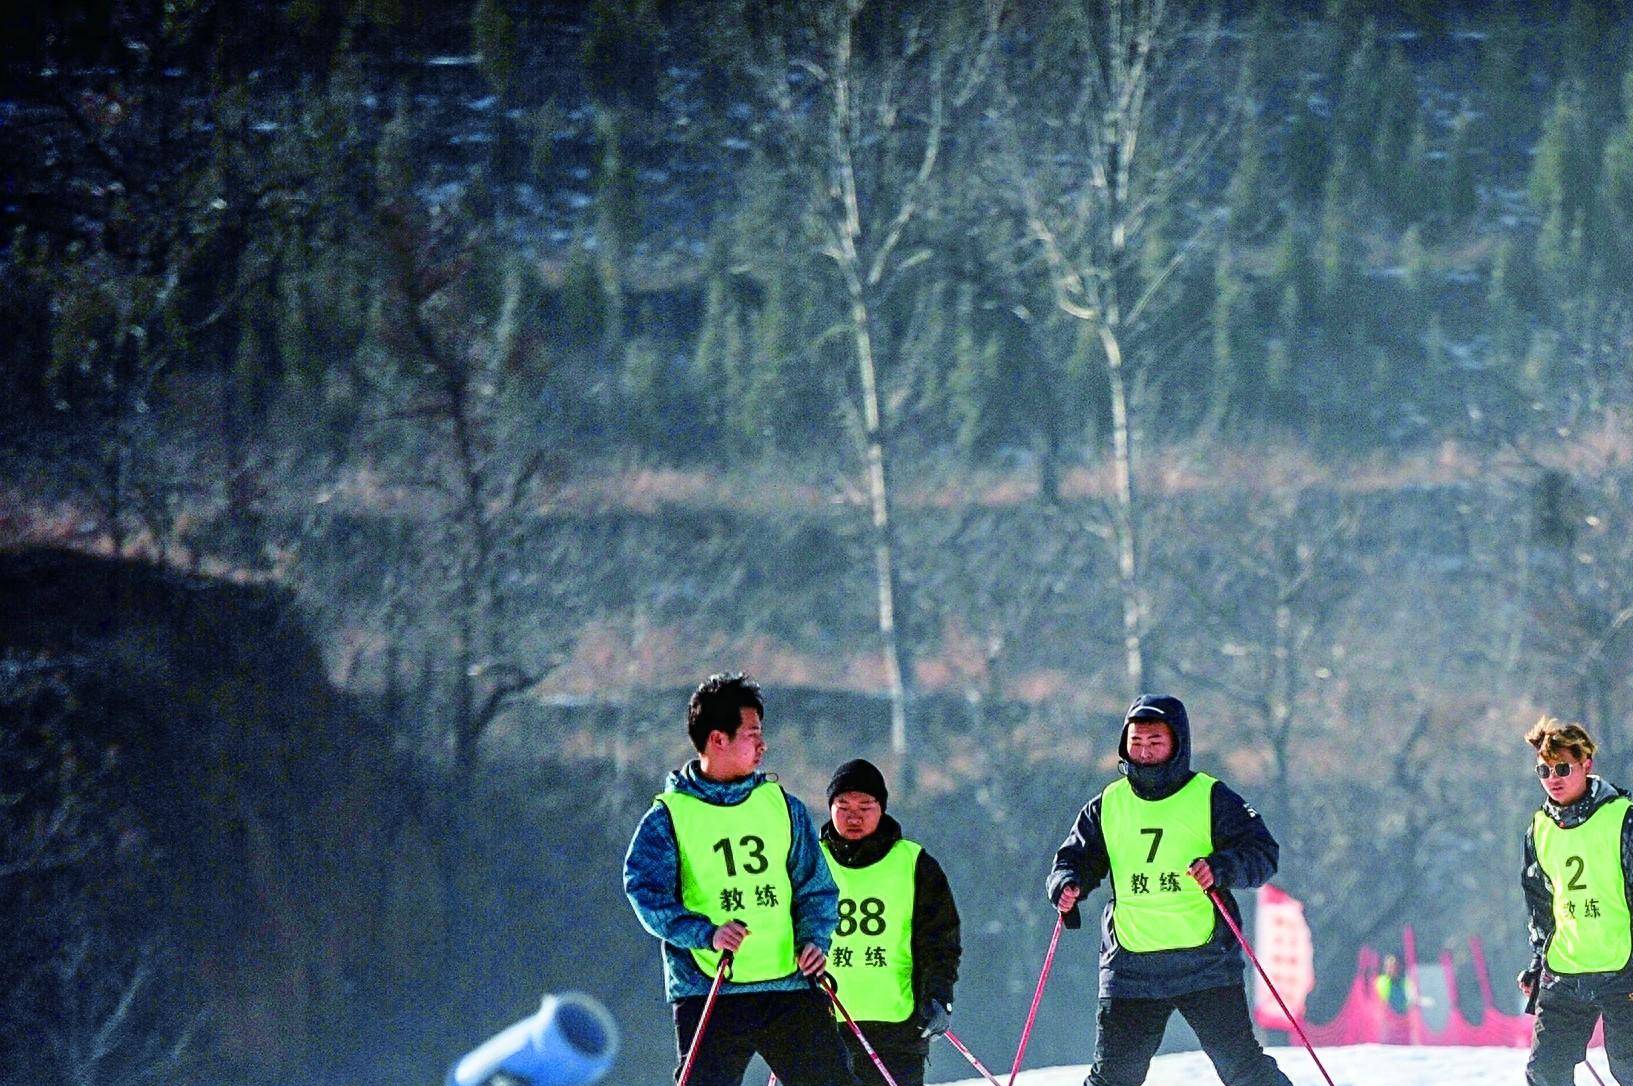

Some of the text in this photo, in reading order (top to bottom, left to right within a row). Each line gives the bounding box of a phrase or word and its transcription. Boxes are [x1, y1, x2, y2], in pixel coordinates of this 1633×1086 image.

[713, 835, 768, 876] 13
[1141, 828, 1163, 863] 7
[1131, 872, 1181, 893] 教练
[1565, 856, 1586, 890] 2
[720, 884, 778, 911] 教练
[835, 898, 886, 936] 88
[833, 947, 887, 968] 教练
